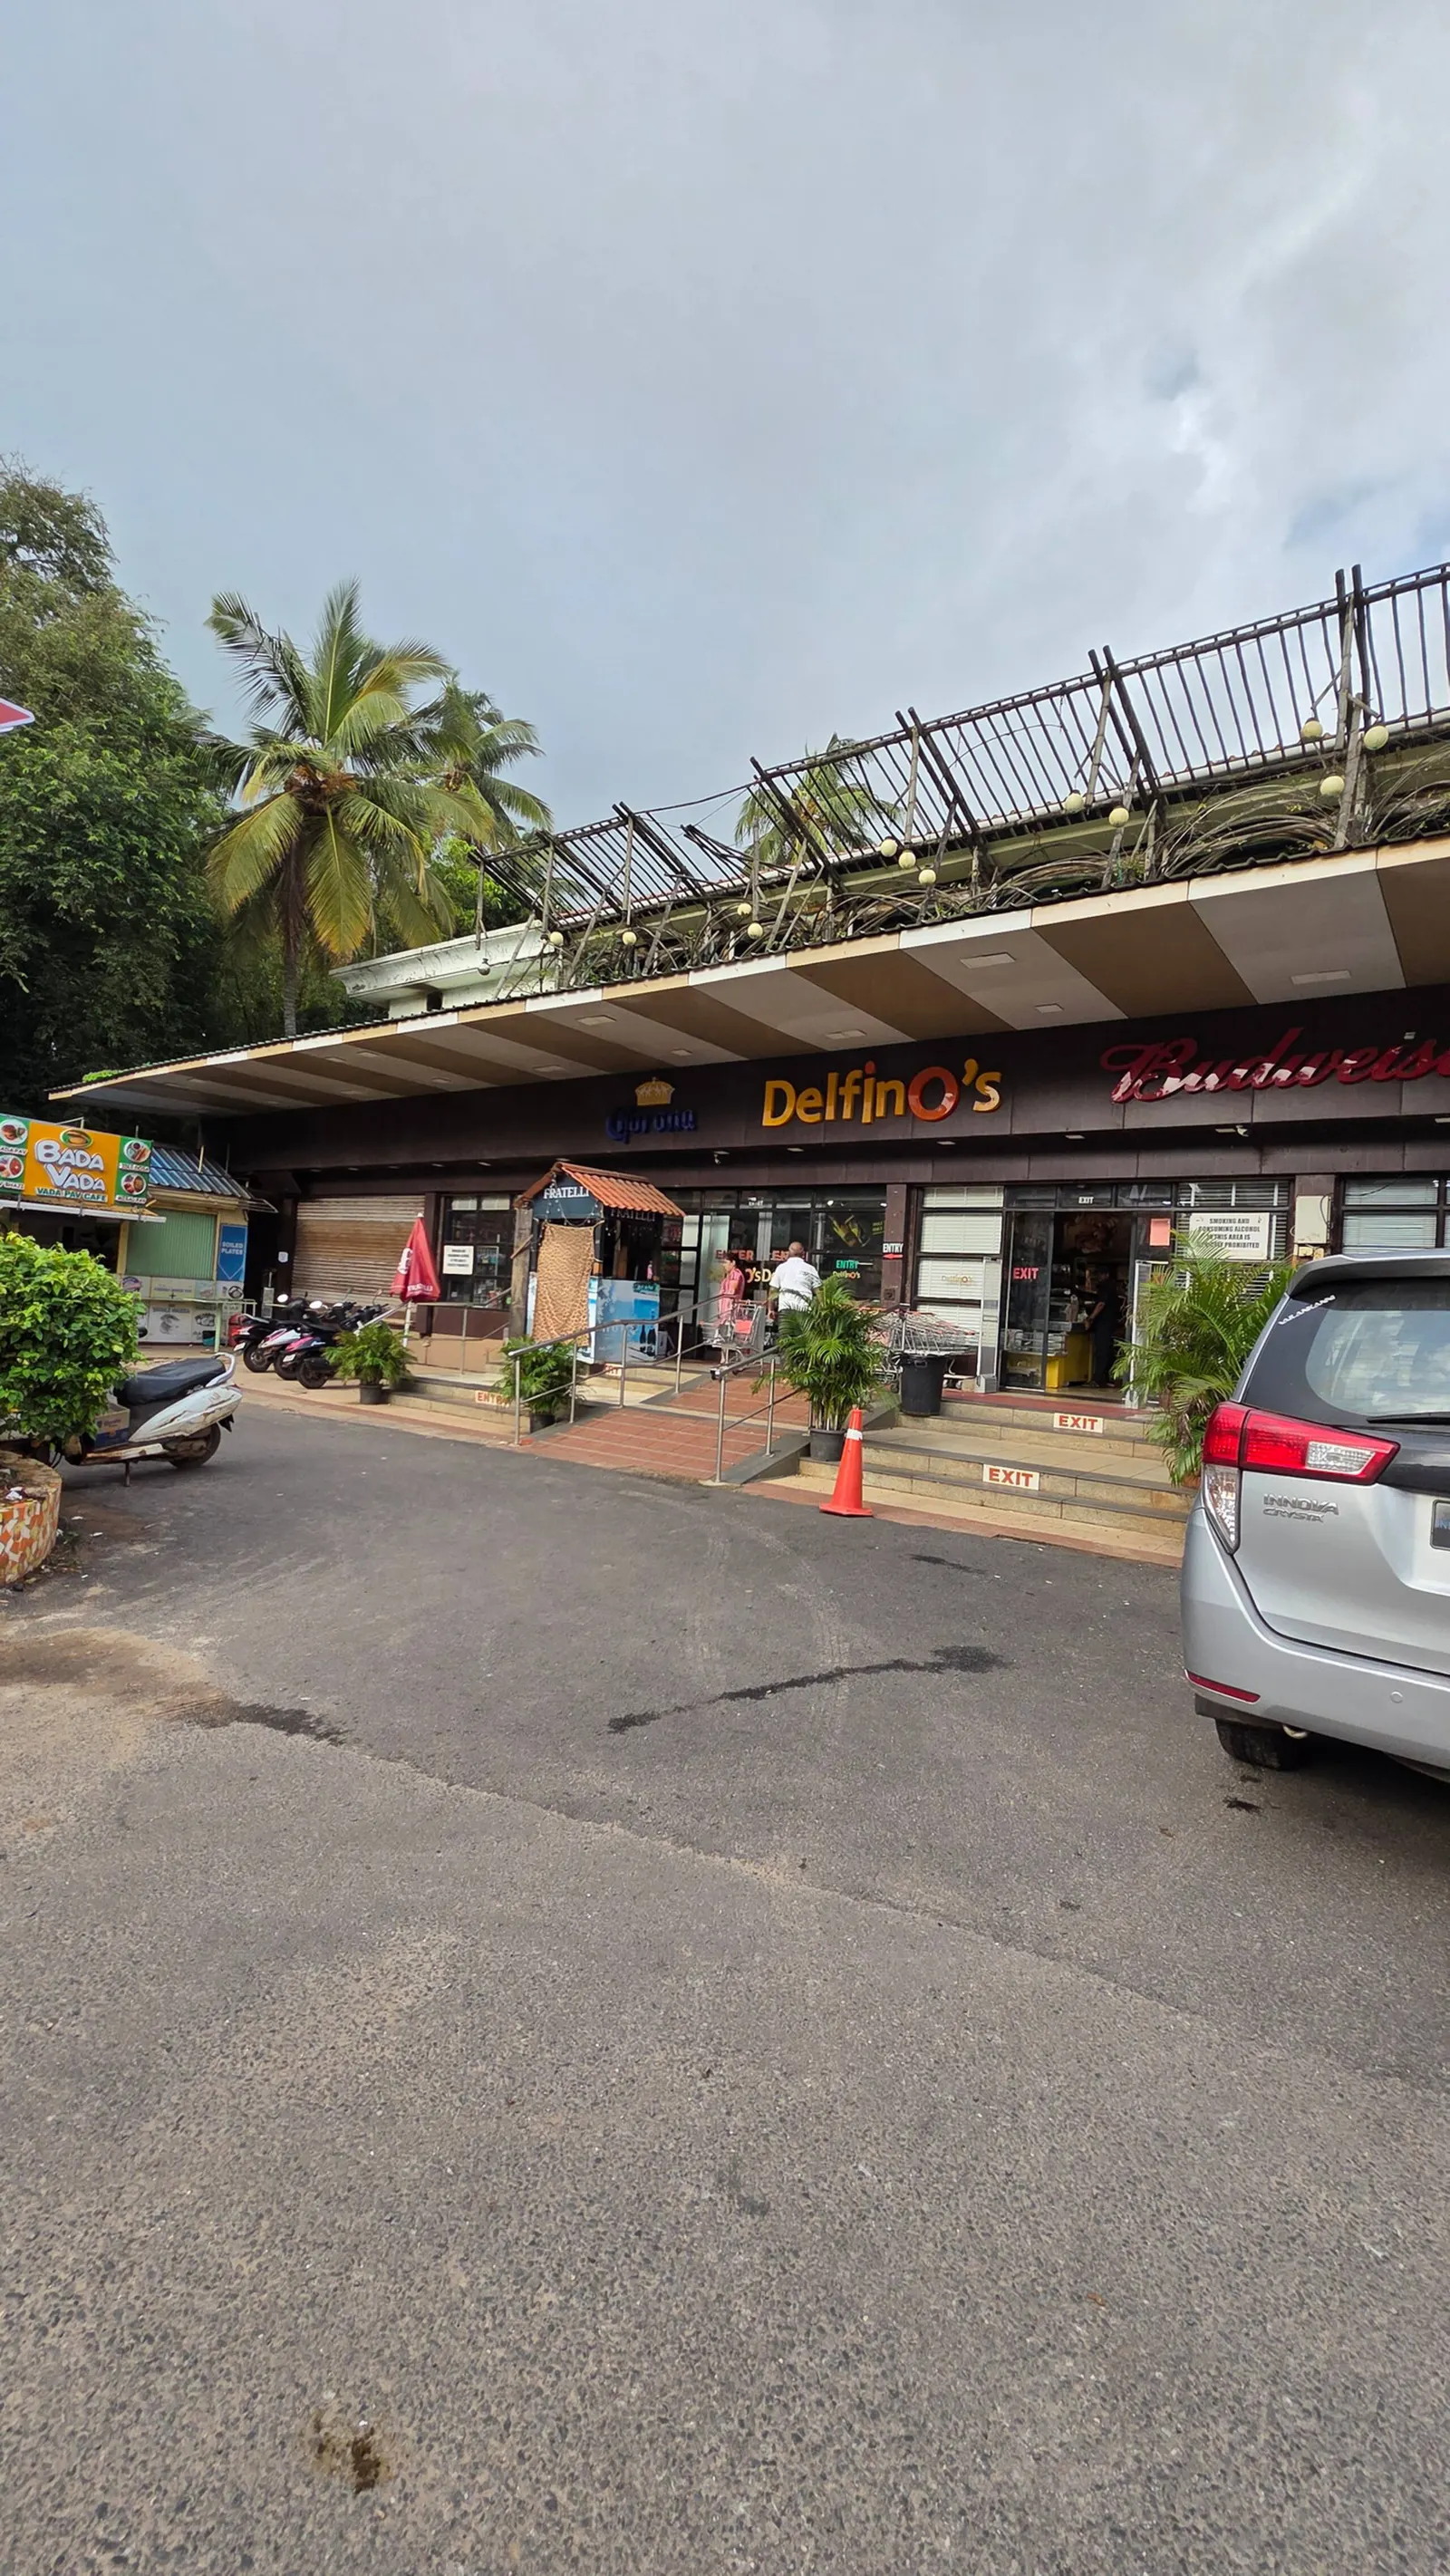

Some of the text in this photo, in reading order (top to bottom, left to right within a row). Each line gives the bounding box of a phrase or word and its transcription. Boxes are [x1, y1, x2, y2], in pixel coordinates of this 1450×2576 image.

[762, 1058, 1002, 1127] DelfinO's
[605, 1109, 696, 1143] Corona
[34, 1139, 105, 1172] BADA
[44, 1163, 106, 1192] VADA
[37, 1187, 107, 1202] VADA PAV CAFE
[544, 1185, 589, 1199] FRATELLI
[1078, 1196, 1095, 1204] EXIT
[221, 1248, 243, 1256] PLATES
[883, 1242, 904, 1253] ENTRY
[836, 1259, 859, 1269] ENTRY
[1013, 1268, 1039, 1279] EXIT
[1058, 1415, 1098, 1430] EXIT
[989, 1468, 1033, 1487] EXIT
[1263, 1493, 1339, 1515] INNOVA
[1262, 1508, 1324, 1523] CRYSTA
